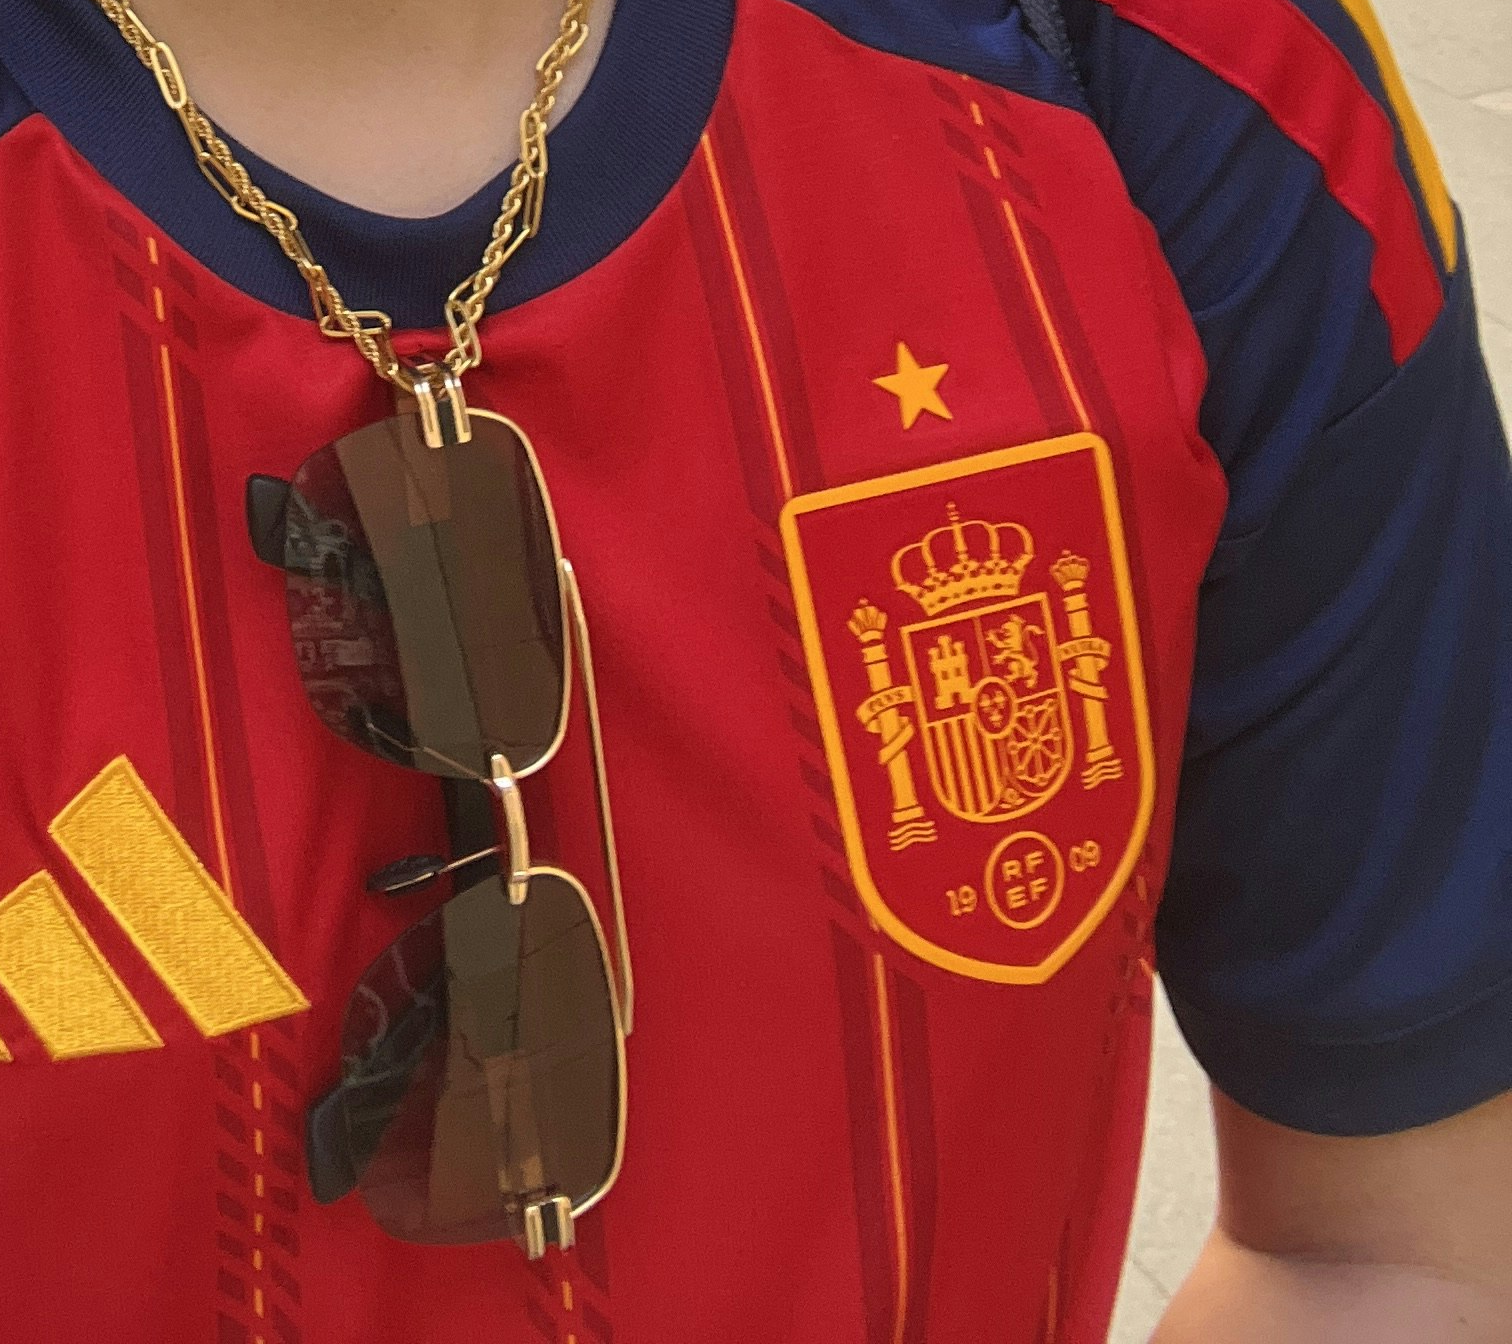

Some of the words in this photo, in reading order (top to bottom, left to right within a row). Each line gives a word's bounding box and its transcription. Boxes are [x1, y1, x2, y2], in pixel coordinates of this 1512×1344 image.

[1002, 850, 1045, 882] RF
[1069, 840, 1101, 872] 09
[945, 885, 978, 916] 19
[1006, 877, 1049, 910] EF
